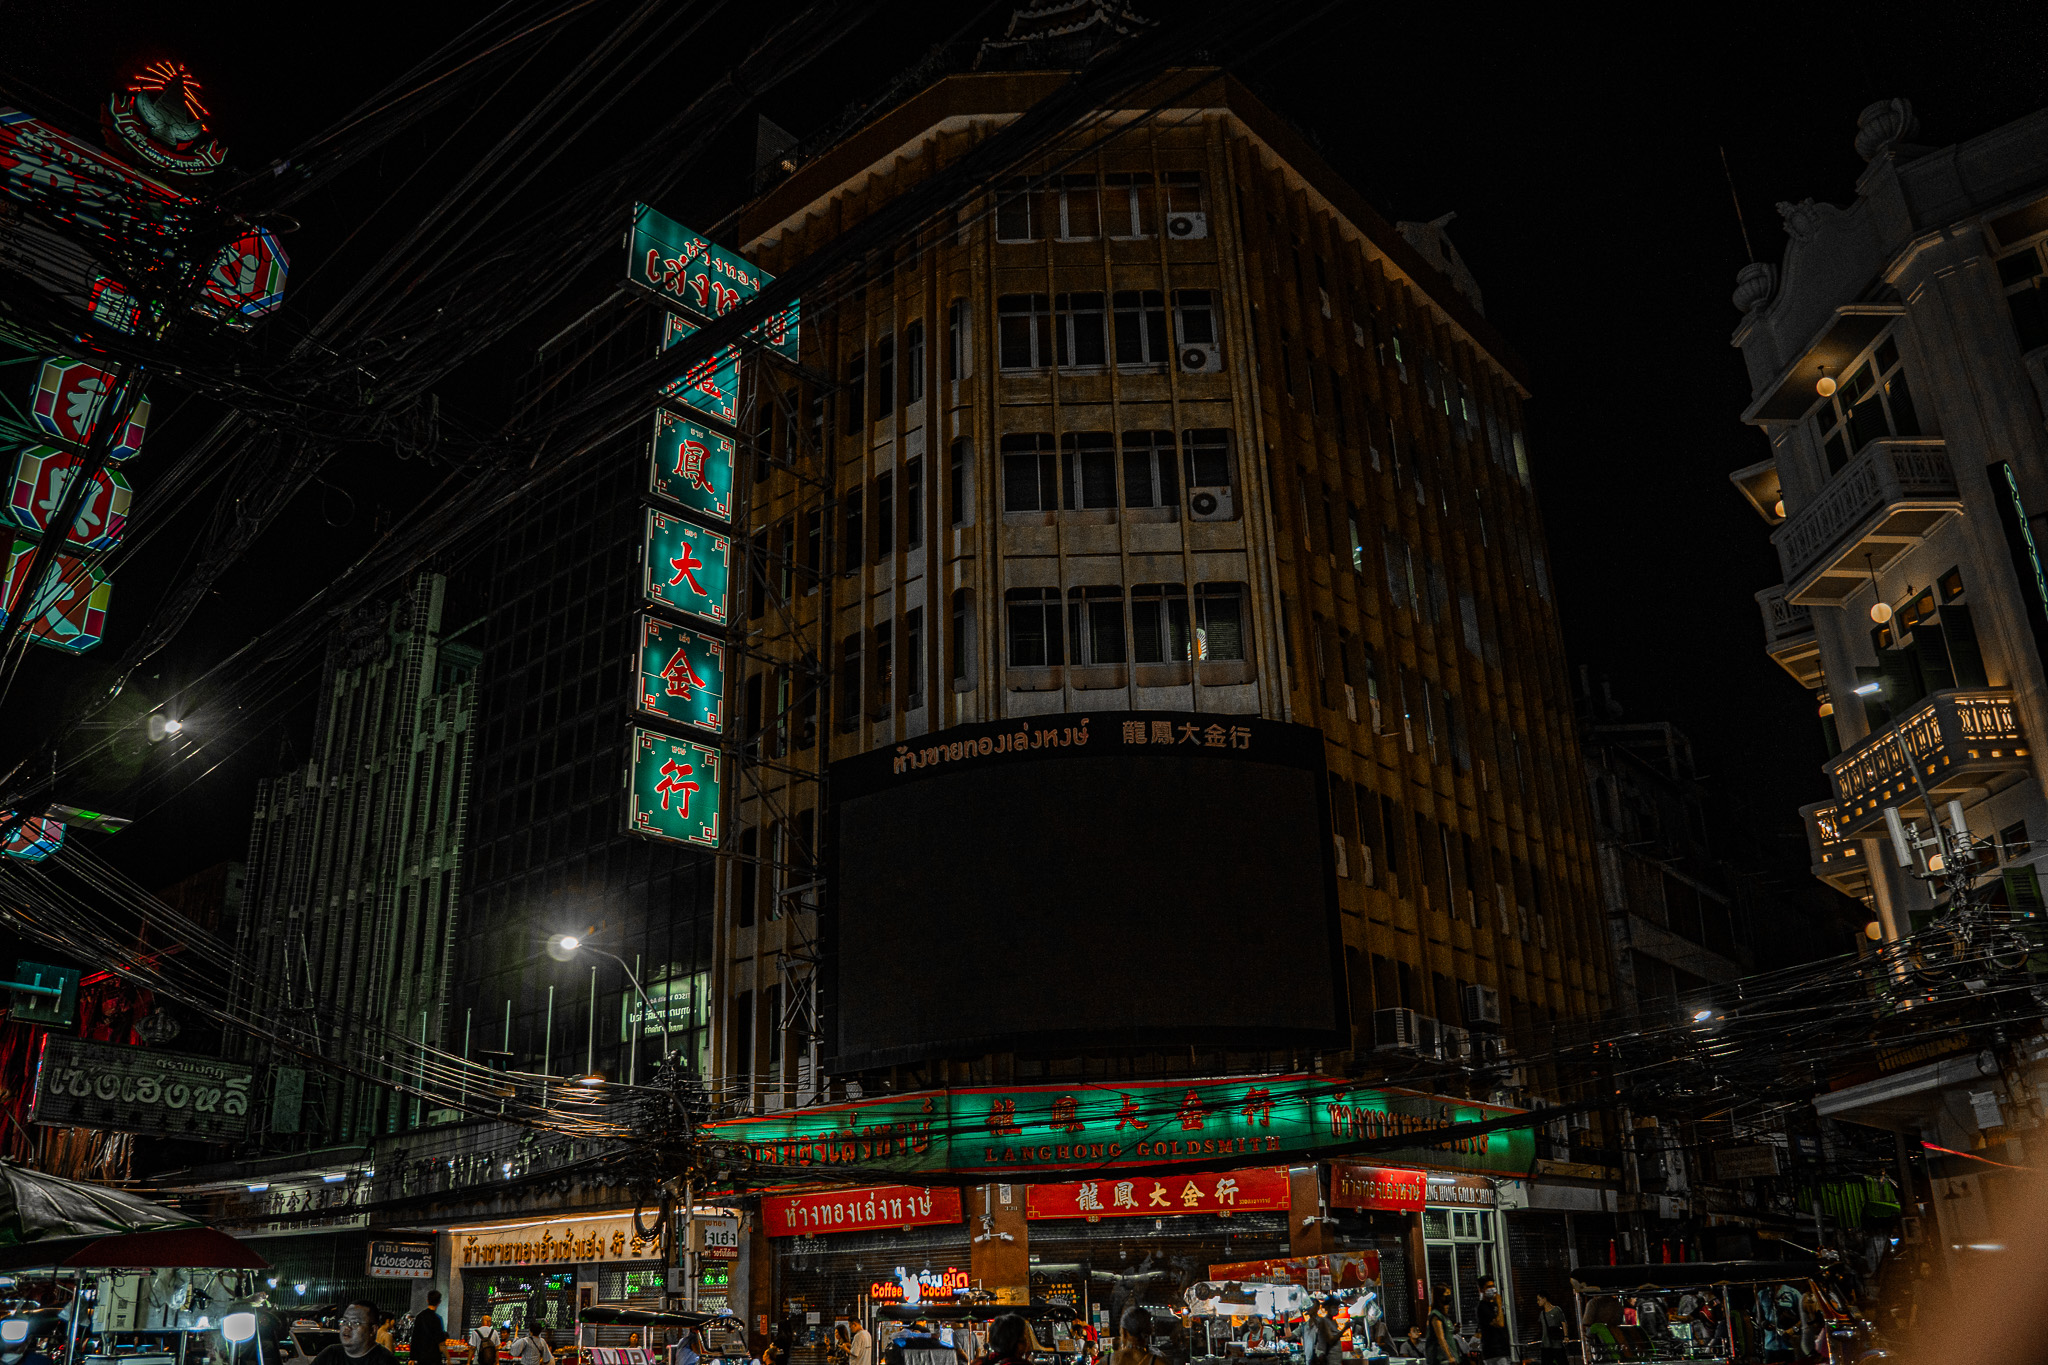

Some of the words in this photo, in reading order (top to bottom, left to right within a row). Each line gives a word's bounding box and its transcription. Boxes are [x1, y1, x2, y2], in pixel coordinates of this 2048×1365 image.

[684, 238, 761, 292] ห้างทอง
[645, 248, 790, 347] เล่งหษ์
[50, 1056, 253, 1117] เซ่งเฮงหลี
[984, 1142, 1122, 1162] LANGHONG
[1136, 1135, 1281, 1157] GOLDSMITH
[784, 1186, 933, 1228] ห้างทองเล่งหงษ์
[1439, 1184, 1457, 1203] HONG
[1458, 1187, 1475, 1204] GOLD
[374, 1254, 432, 1269] เซ่งเฮงหลี
[871, 1281, 903, 1299] Coffee
[921, 1283, 953, 1298] Cocoa
